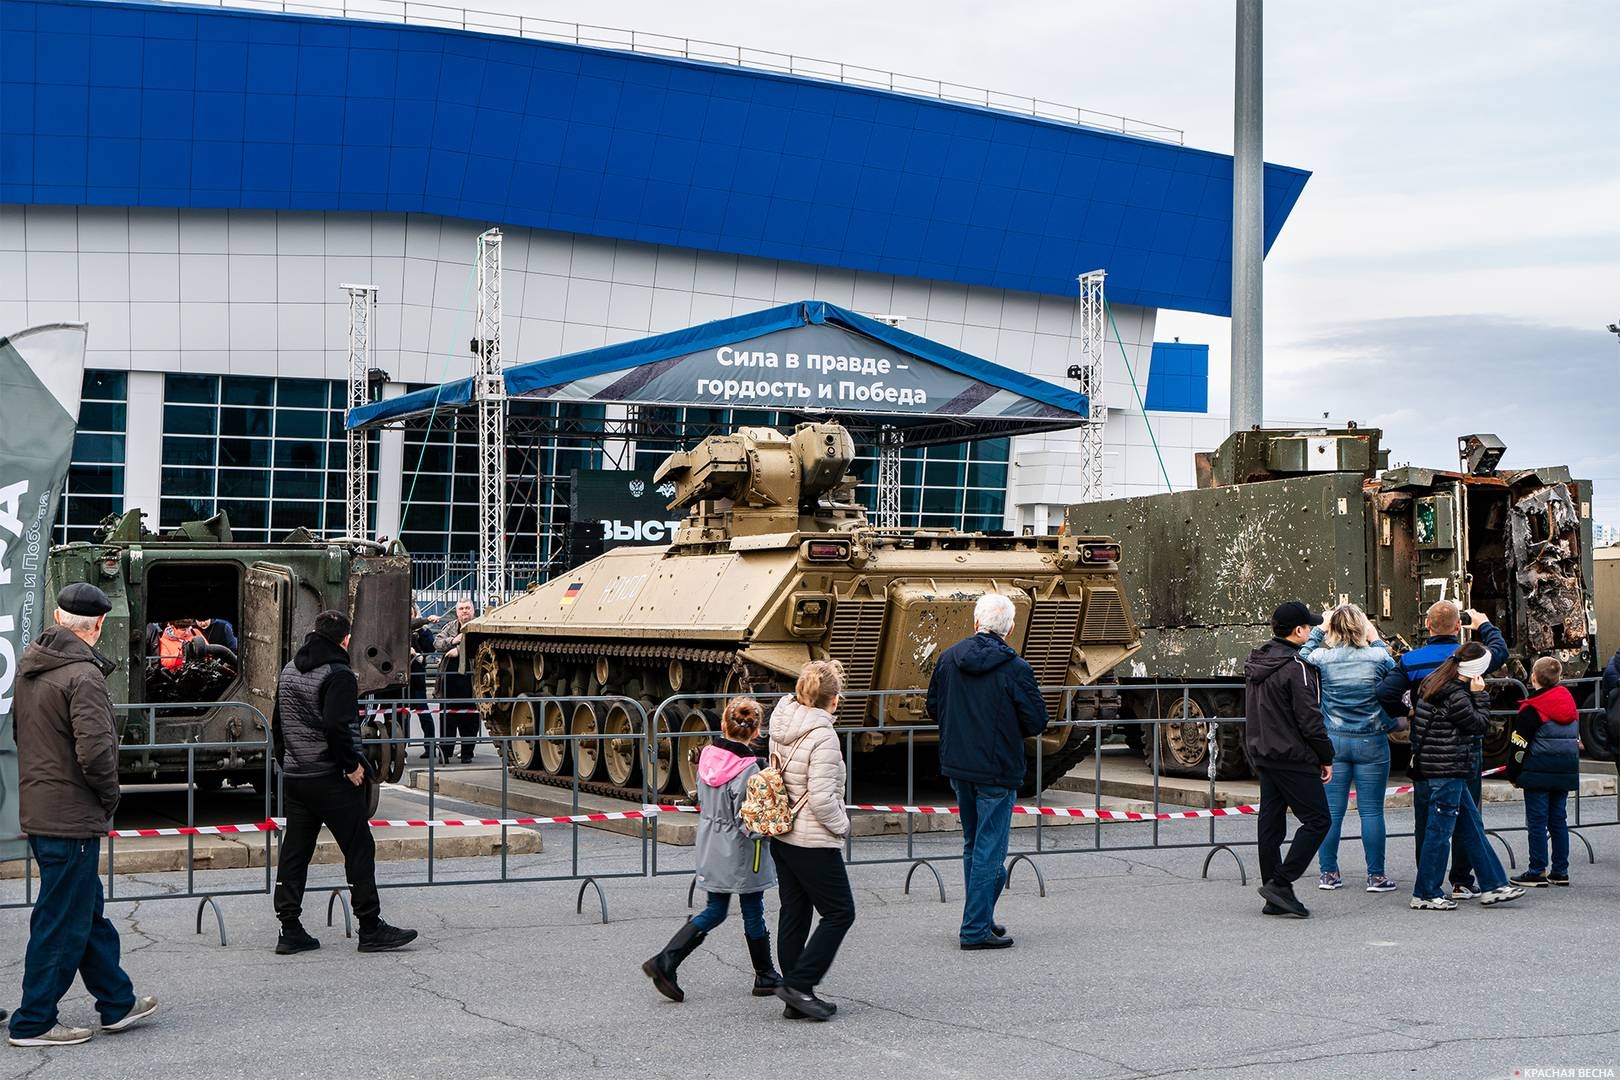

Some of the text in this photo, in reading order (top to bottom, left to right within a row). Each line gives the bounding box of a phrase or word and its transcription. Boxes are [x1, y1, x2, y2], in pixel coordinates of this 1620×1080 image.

[716, 347, 778, 368] Сила
[785, 352, 799, 369] в
[807, 354, 890, 376] правде
[697, 379, 927, 405] гордость и Победа
[600, 519, 681, 541] ВЫСТ
[24, 574, 36, 587] и
